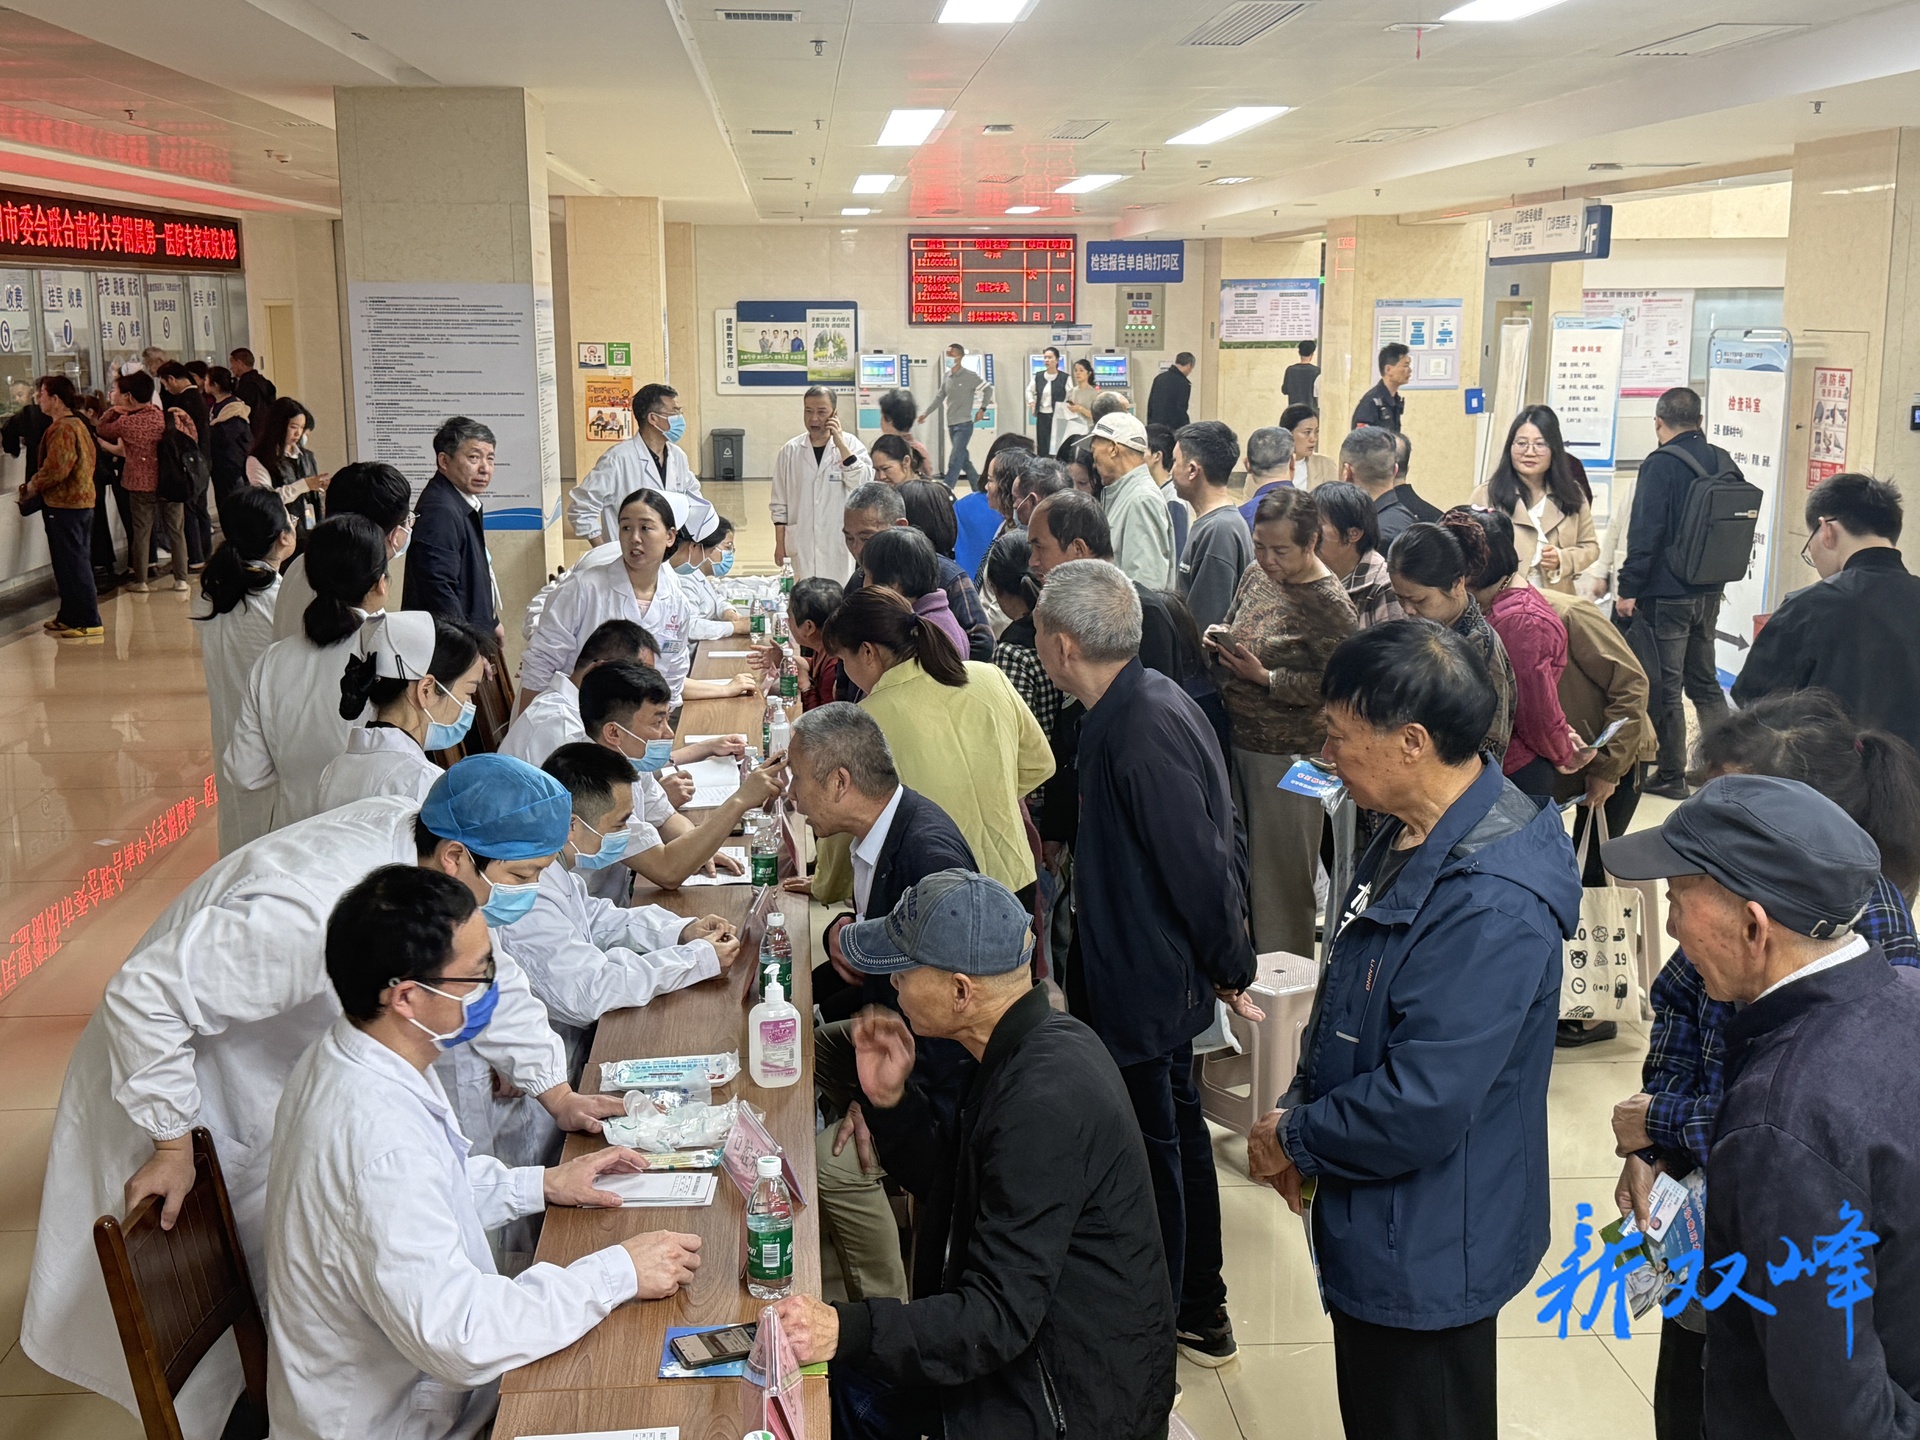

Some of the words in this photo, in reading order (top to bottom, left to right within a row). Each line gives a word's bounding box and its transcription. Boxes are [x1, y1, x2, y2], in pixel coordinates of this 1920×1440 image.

[0, 200, 237, 260] 市委会联合南华大学附属第一医院专家来院义诊
[1584, 223, 1598, 254] 1F
[1091, 253, 1180, 271] 检验报告单自助打印区
[726, 318, 734, 368] 健康教育宣传栏
[1819, 372, 1847, 387] 消防栓
[1728, 395, 1761, 413] 检查科室
[1614, 952, 1627, 966] 19
